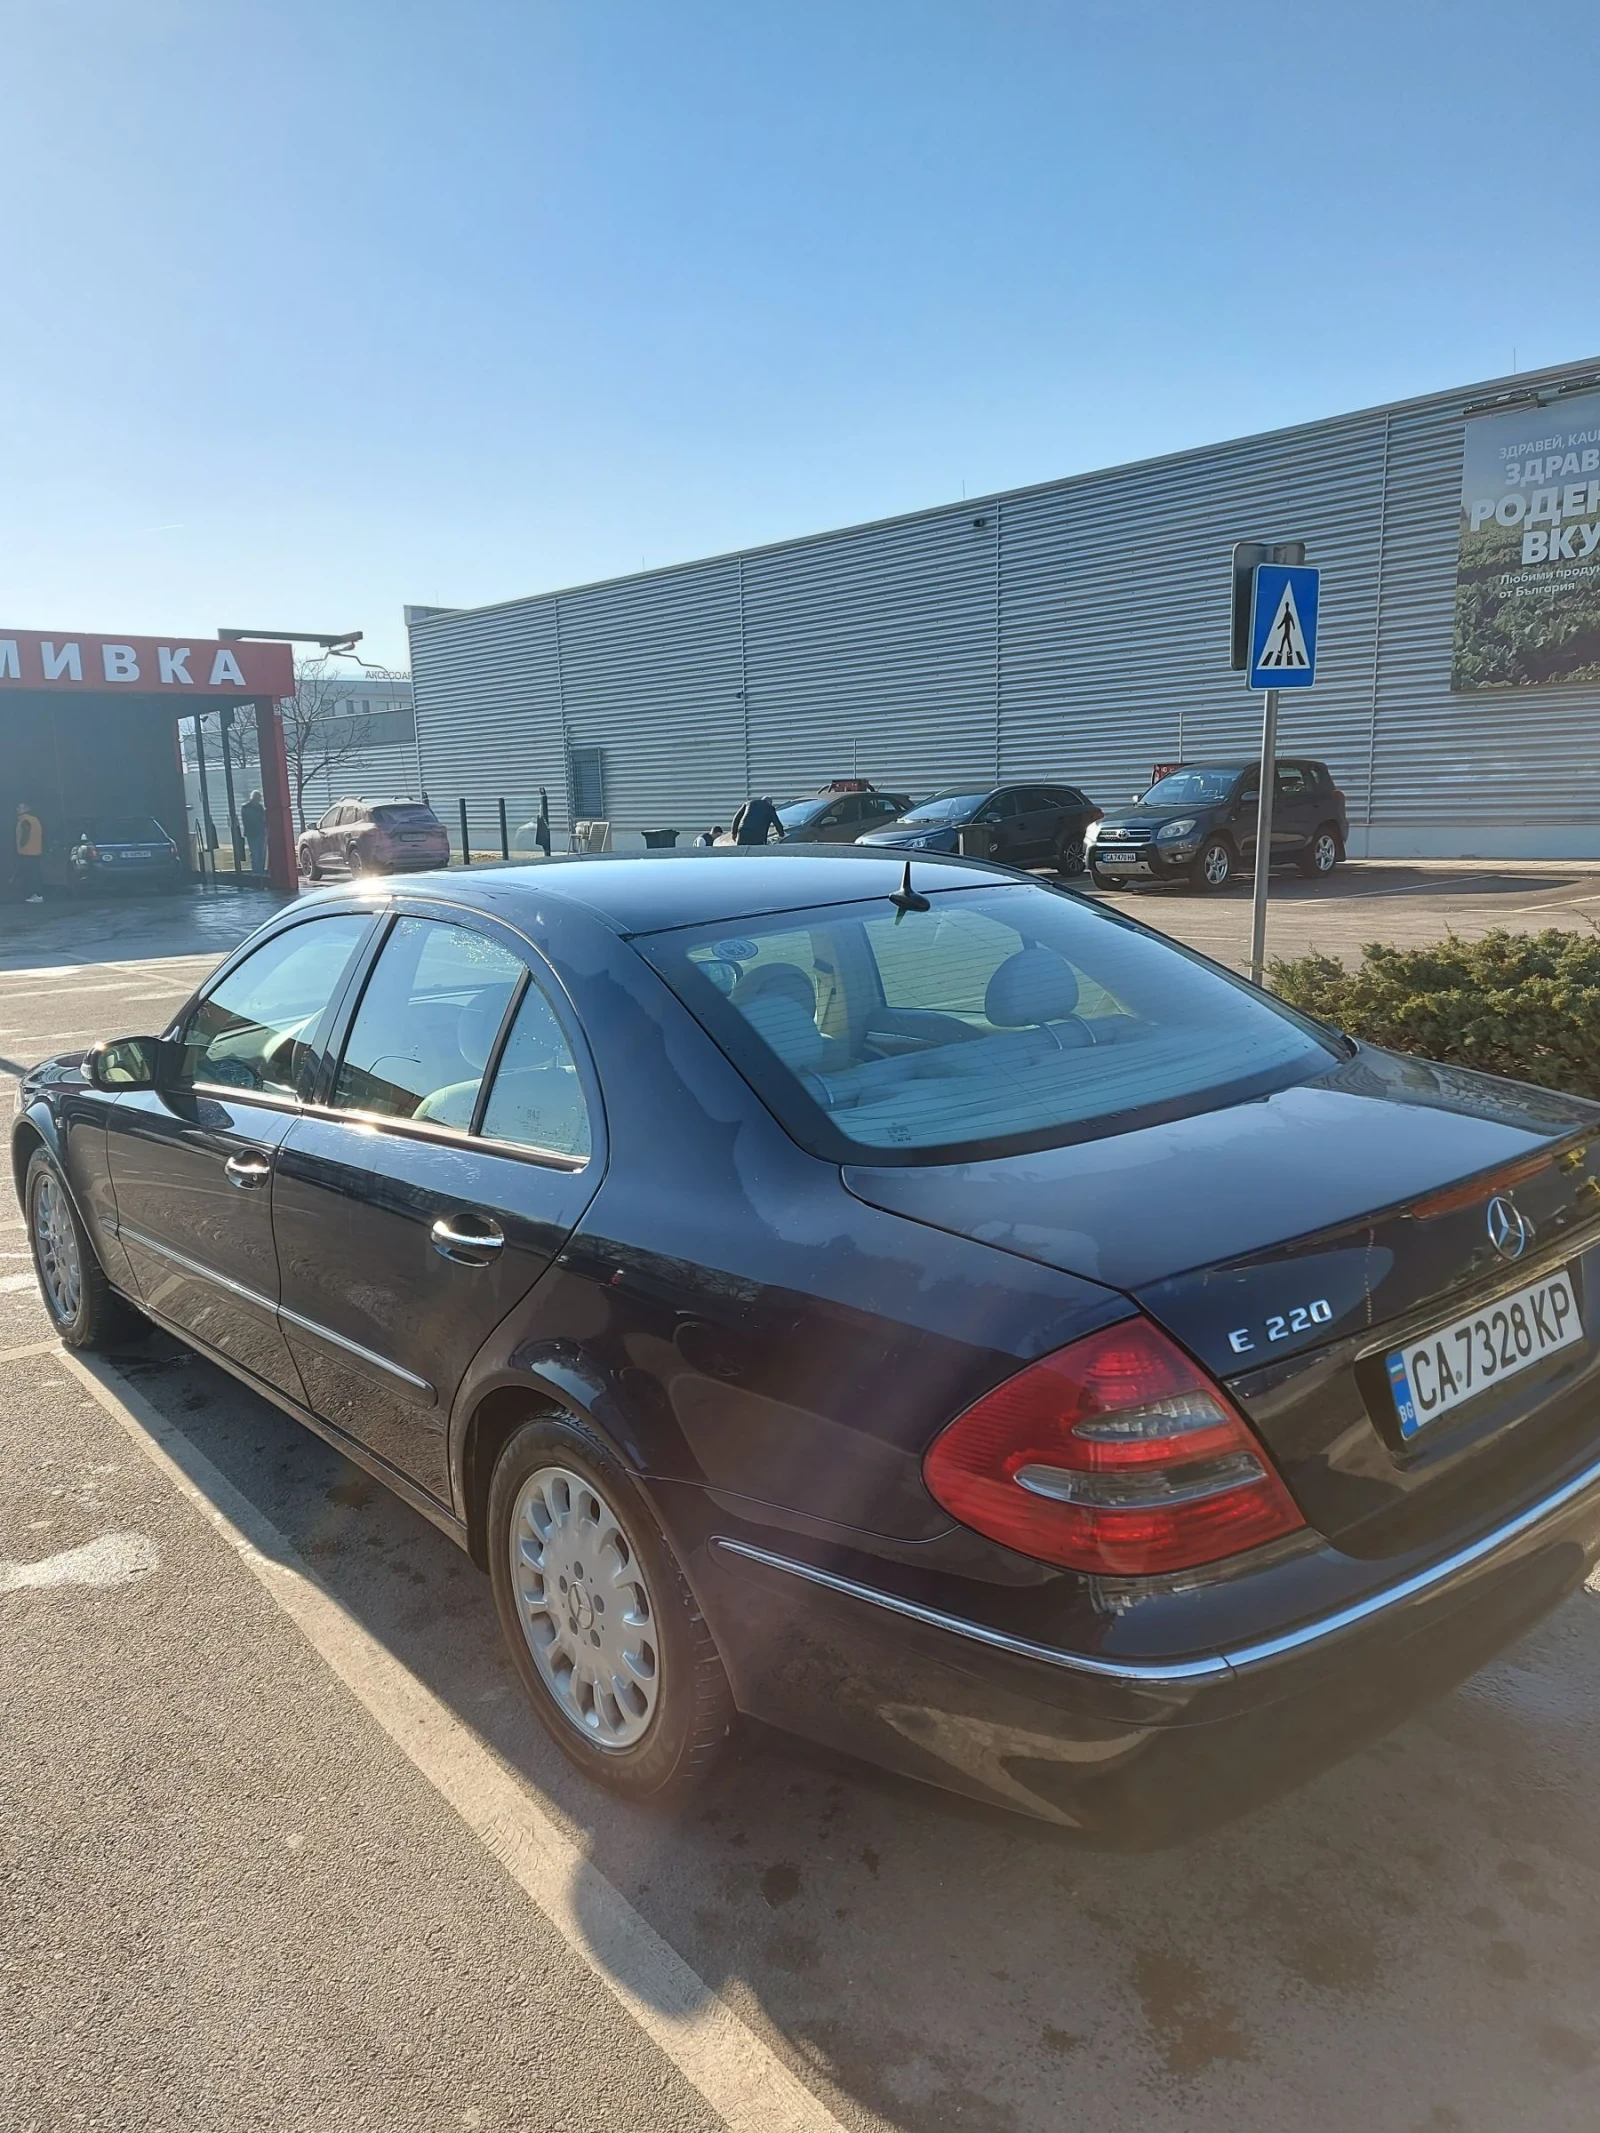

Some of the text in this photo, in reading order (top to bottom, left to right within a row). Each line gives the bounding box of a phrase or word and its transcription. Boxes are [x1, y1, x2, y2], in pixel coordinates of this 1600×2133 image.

[1499, 429, 1600, 460] ЗДРАВЕЙ, KAU
[1505, 449, 1600, 488] ЗДРАВ
[1522, 522, 1600, 565] ВКУ
[1500, 571, 1553, 585] Любими
[1500, 582, 1575, 598] от България
[1228, 1299, 1332, 1353] E 220
[1400, 1401, 1414, 1423] BG
